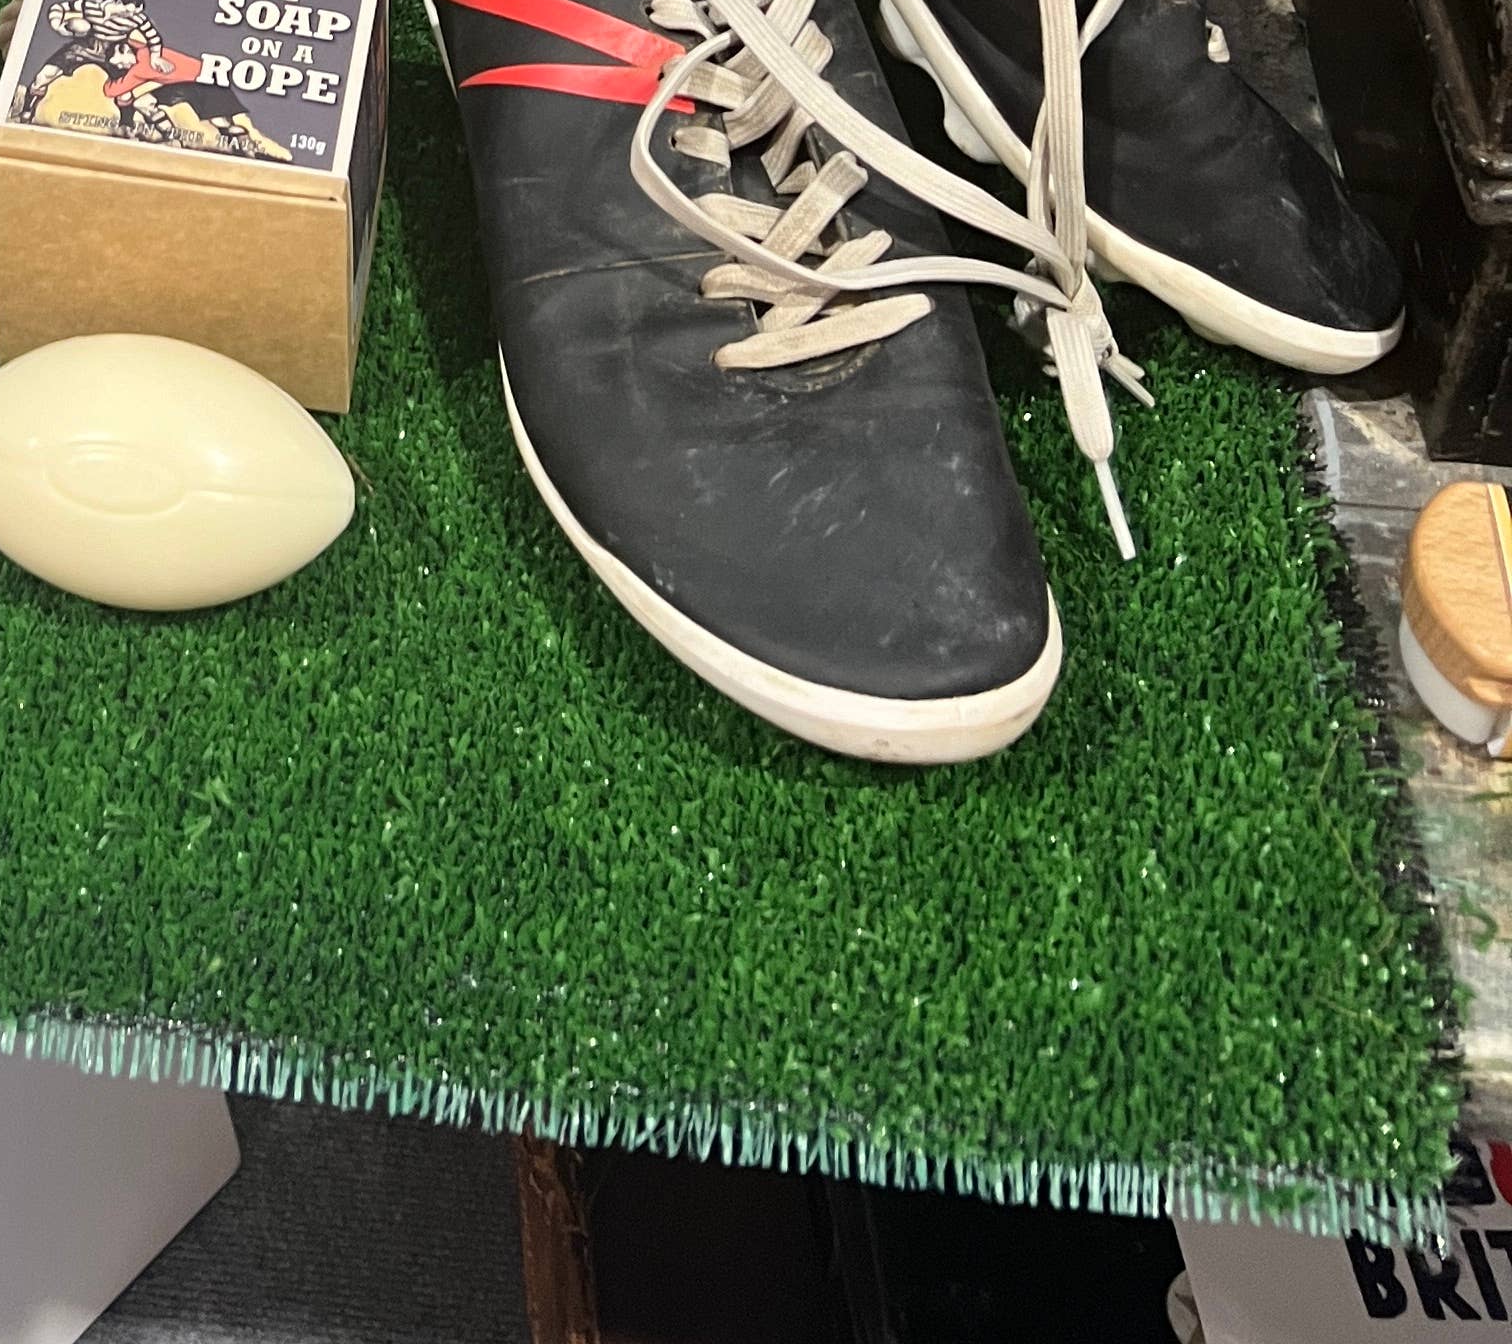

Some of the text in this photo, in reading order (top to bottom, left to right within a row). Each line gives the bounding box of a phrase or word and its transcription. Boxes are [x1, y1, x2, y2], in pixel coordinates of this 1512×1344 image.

[240, 36, 315, 64] ON A
[195, 53, 341, 104] ROPE
[289, 133, 326, 156] 130g
